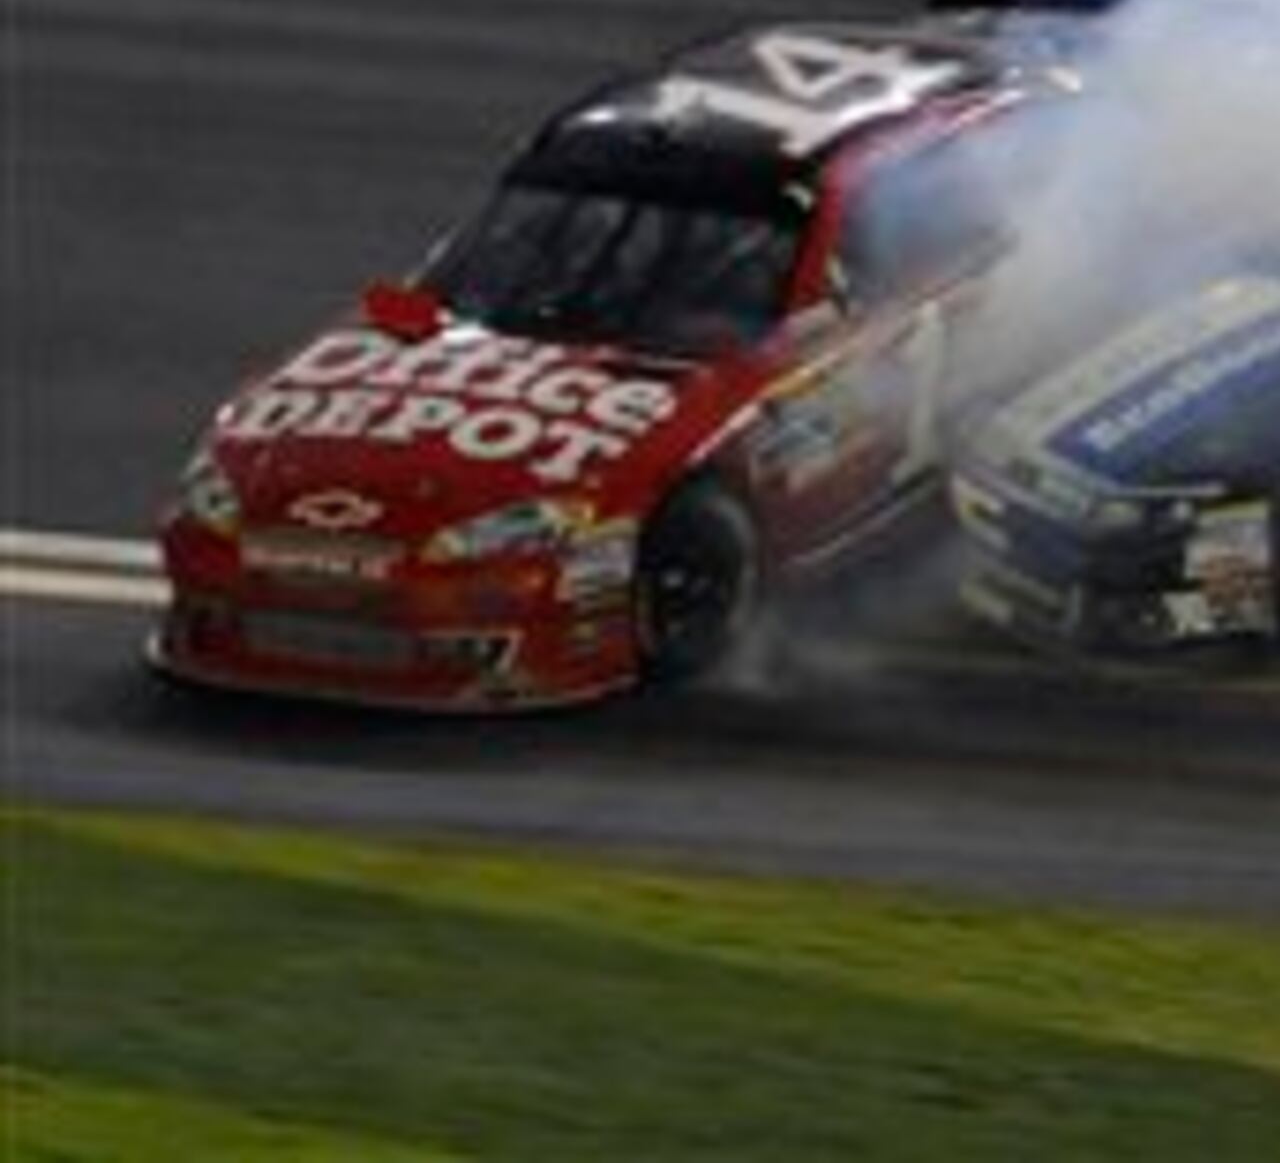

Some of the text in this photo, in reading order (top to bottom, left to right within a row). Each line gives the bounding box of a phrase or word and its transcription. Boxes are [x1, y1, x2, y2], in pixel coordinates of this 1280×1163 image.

[652, 33, 965, 158] 14
[269, 328, 678, 433] Office
[238, 388, 632, 484] DEPOT
